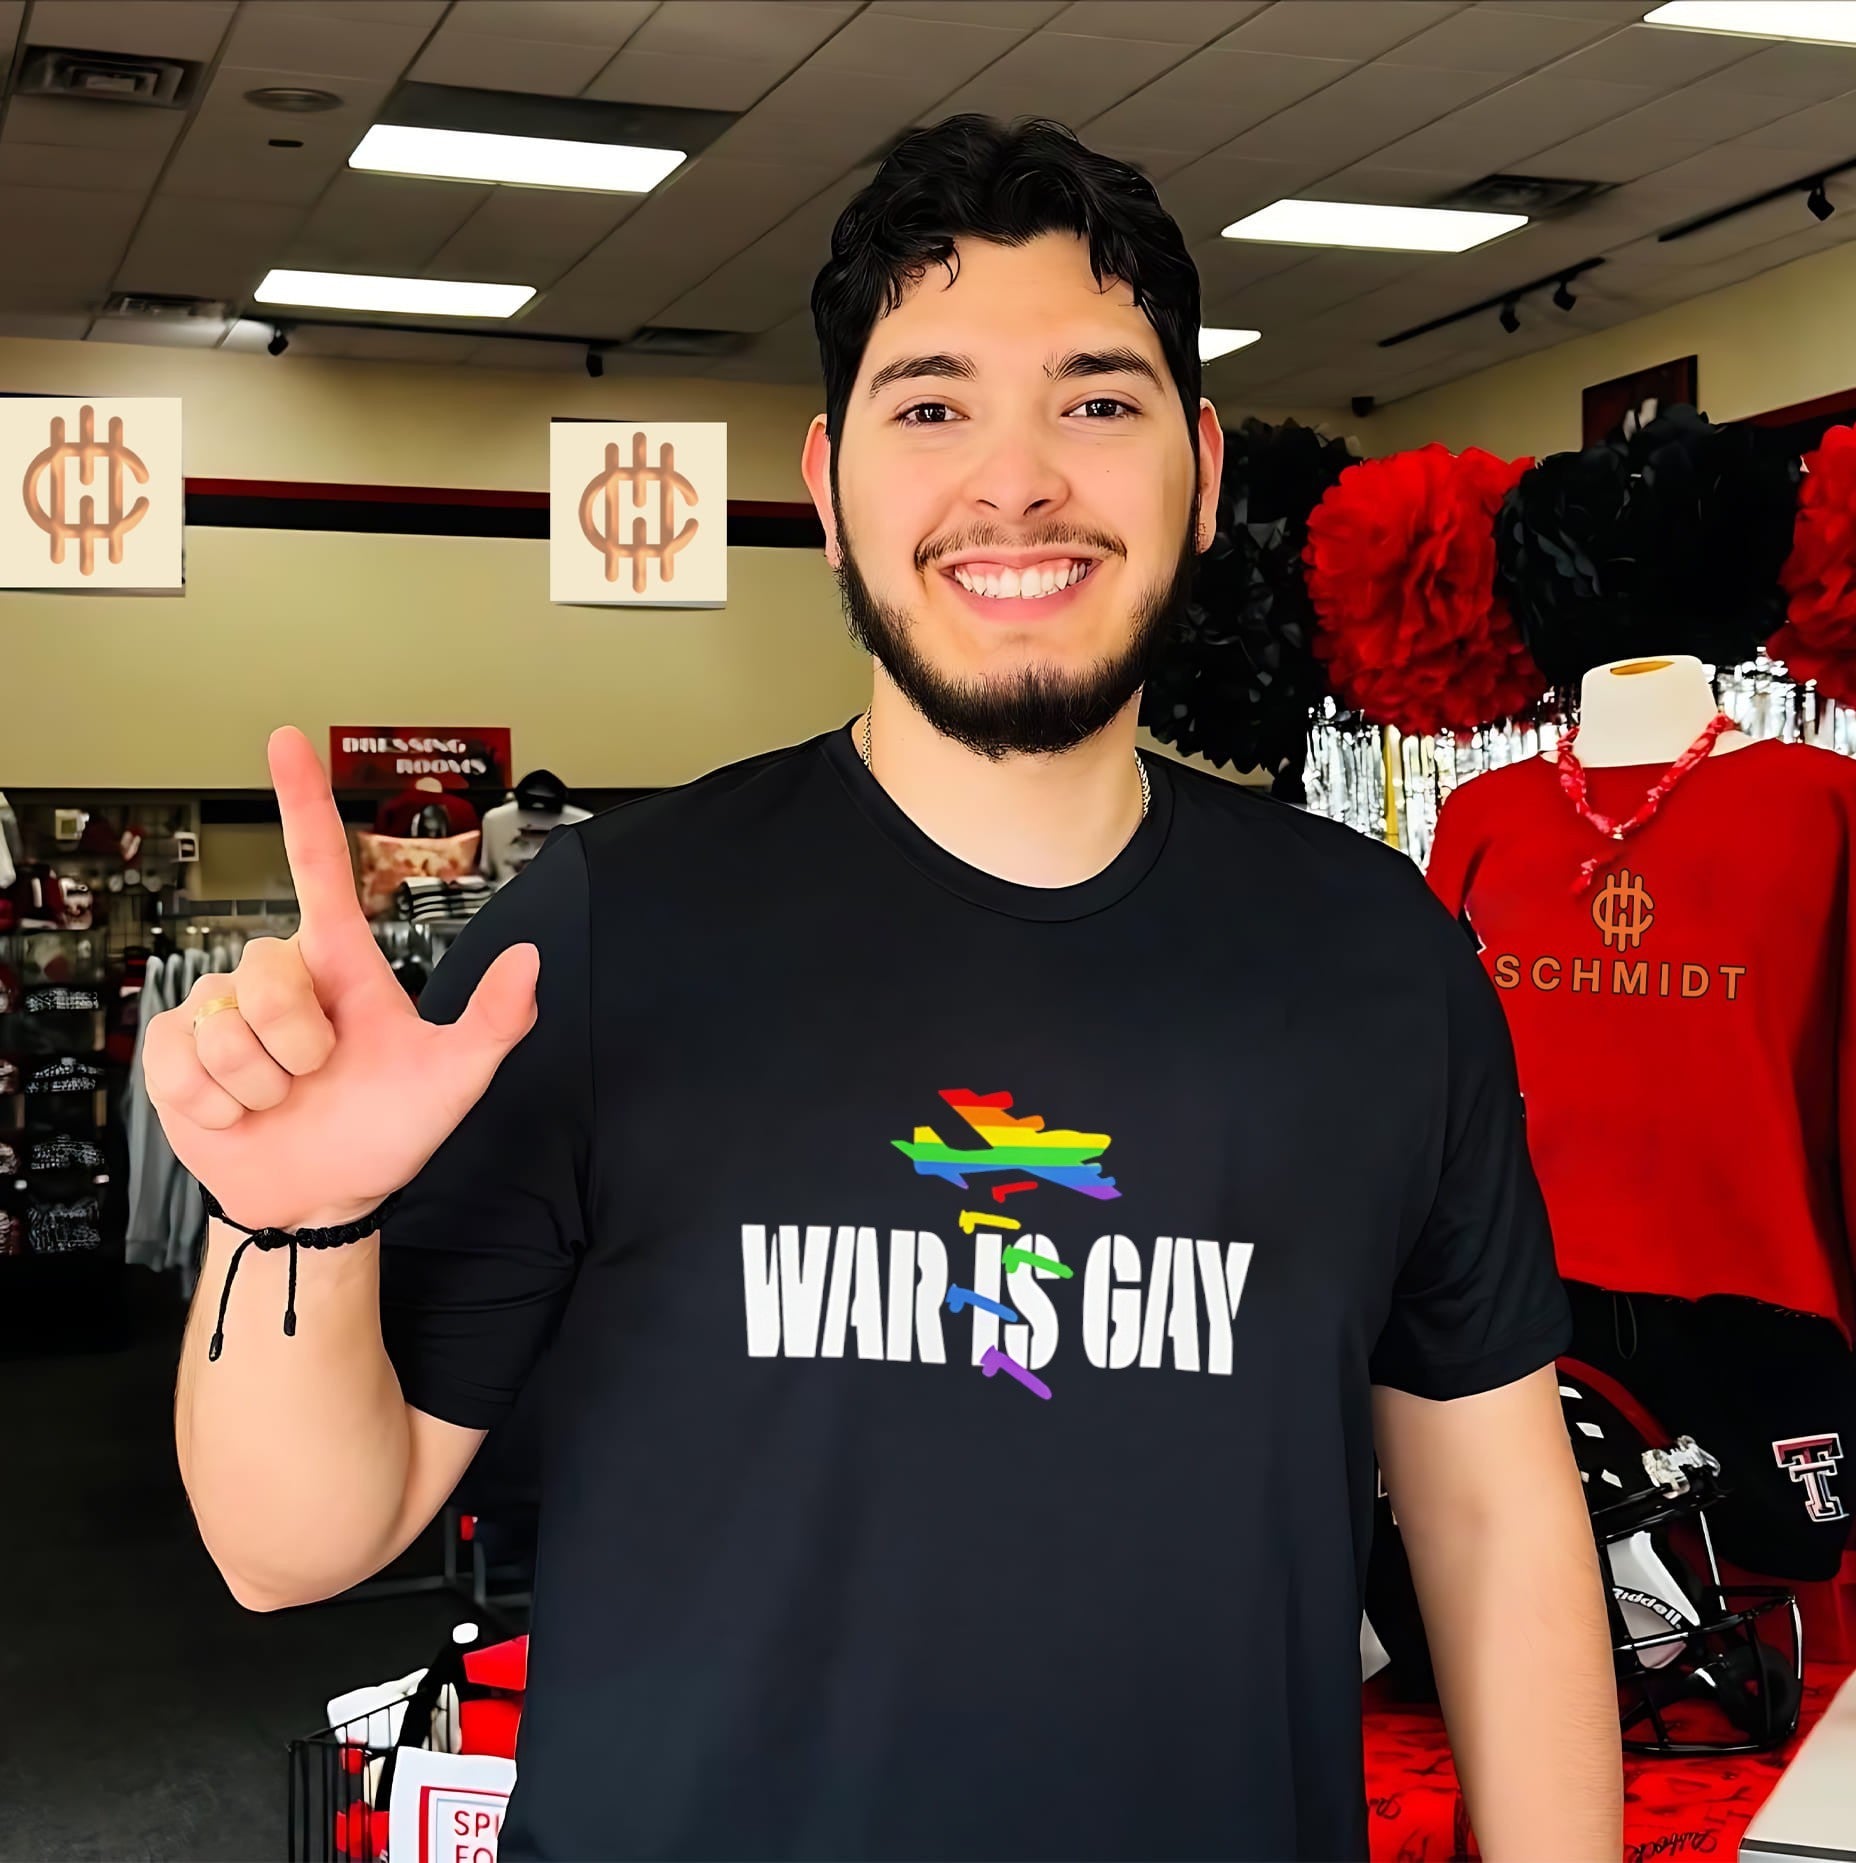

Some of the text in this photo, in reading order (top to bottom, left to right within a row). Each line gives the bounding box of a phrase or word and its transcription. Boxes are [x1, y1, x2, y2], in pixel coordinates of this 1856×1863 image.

[396, 758, 487, 775] ROOMS
[1494, 954, 1746, 1000] SCHMIDT
[741, 1224, 1255, 1376] WAR IS GAY
